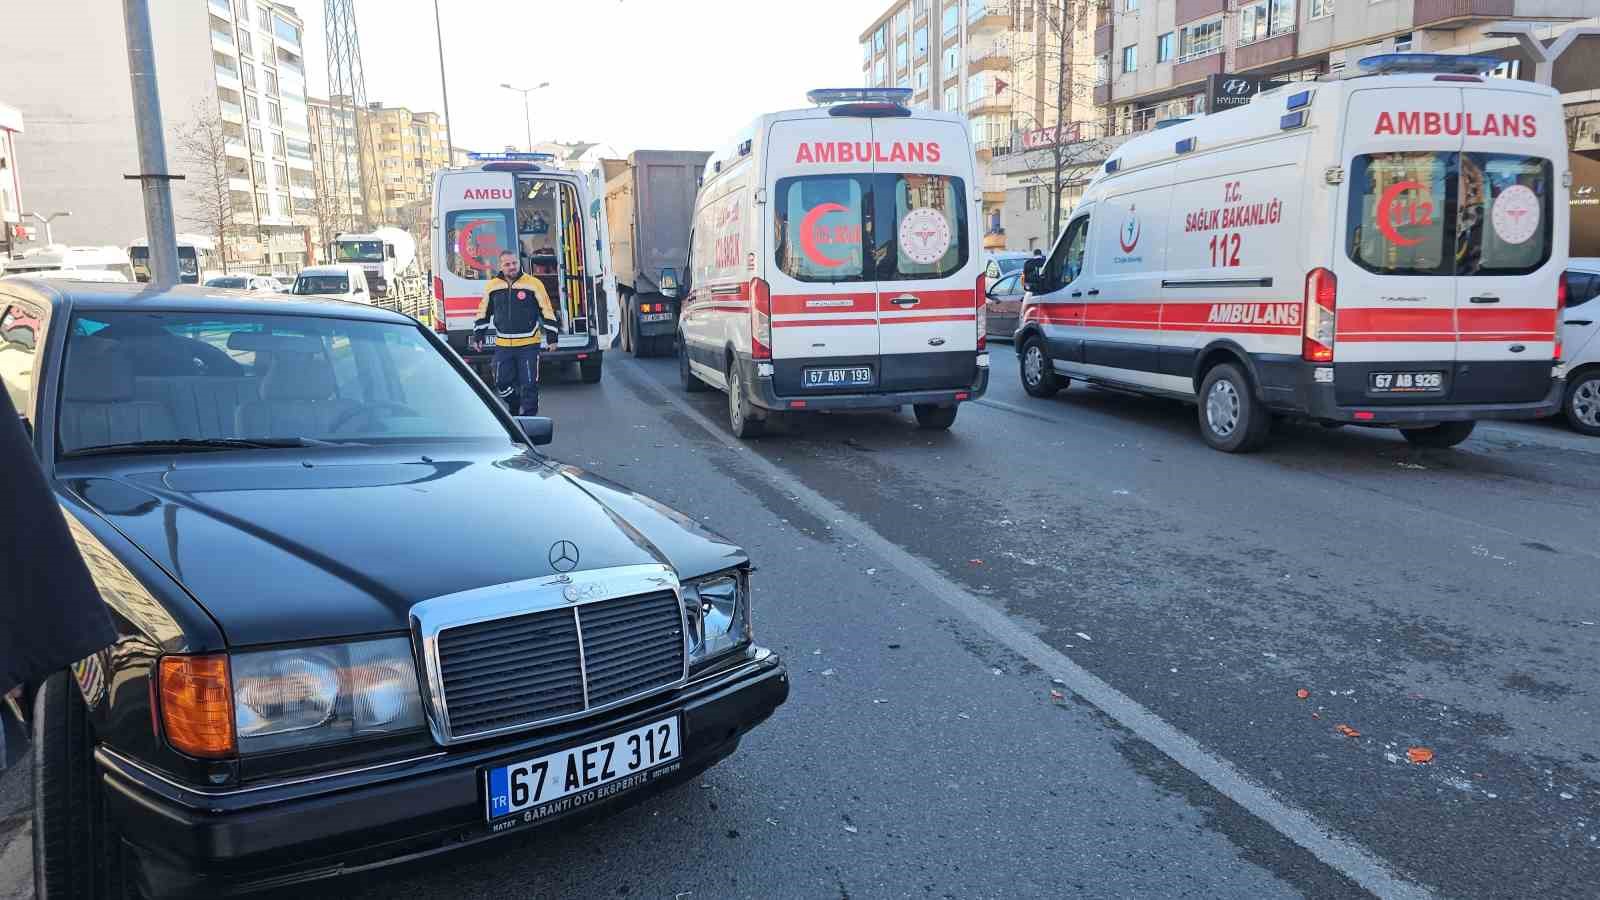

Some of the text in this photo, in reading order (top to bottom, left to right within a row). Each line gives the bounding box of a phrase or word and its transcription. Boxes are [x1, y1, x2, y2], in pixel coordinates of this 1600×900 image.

[1216, 96, 1252, 105] HYUNDA
[1373, 111, 1537, 138] AMBULANS
[795, 141, 942, 163] AMBULANS
[463, 188, 513, 200] AMBU
[1224, 181, 1242, 203] T.C.
[1185, 198, 1283, 232] SAĞLIK BAKANLIĞI
[1393, 201, 1434, 225] 112
[1209, 232, 1241, 268] 112
[1207, 303, 1300, 325] AMBULANS
[810, 369, 869, 383] 67 ABV 193
[1375, 373, 1441, 388] 67 AB 926
[510, 723, 672, 807] 67 AEZ 312
[492, 794, 507, 809] TR
[573, 791, 595, 807] OTO
